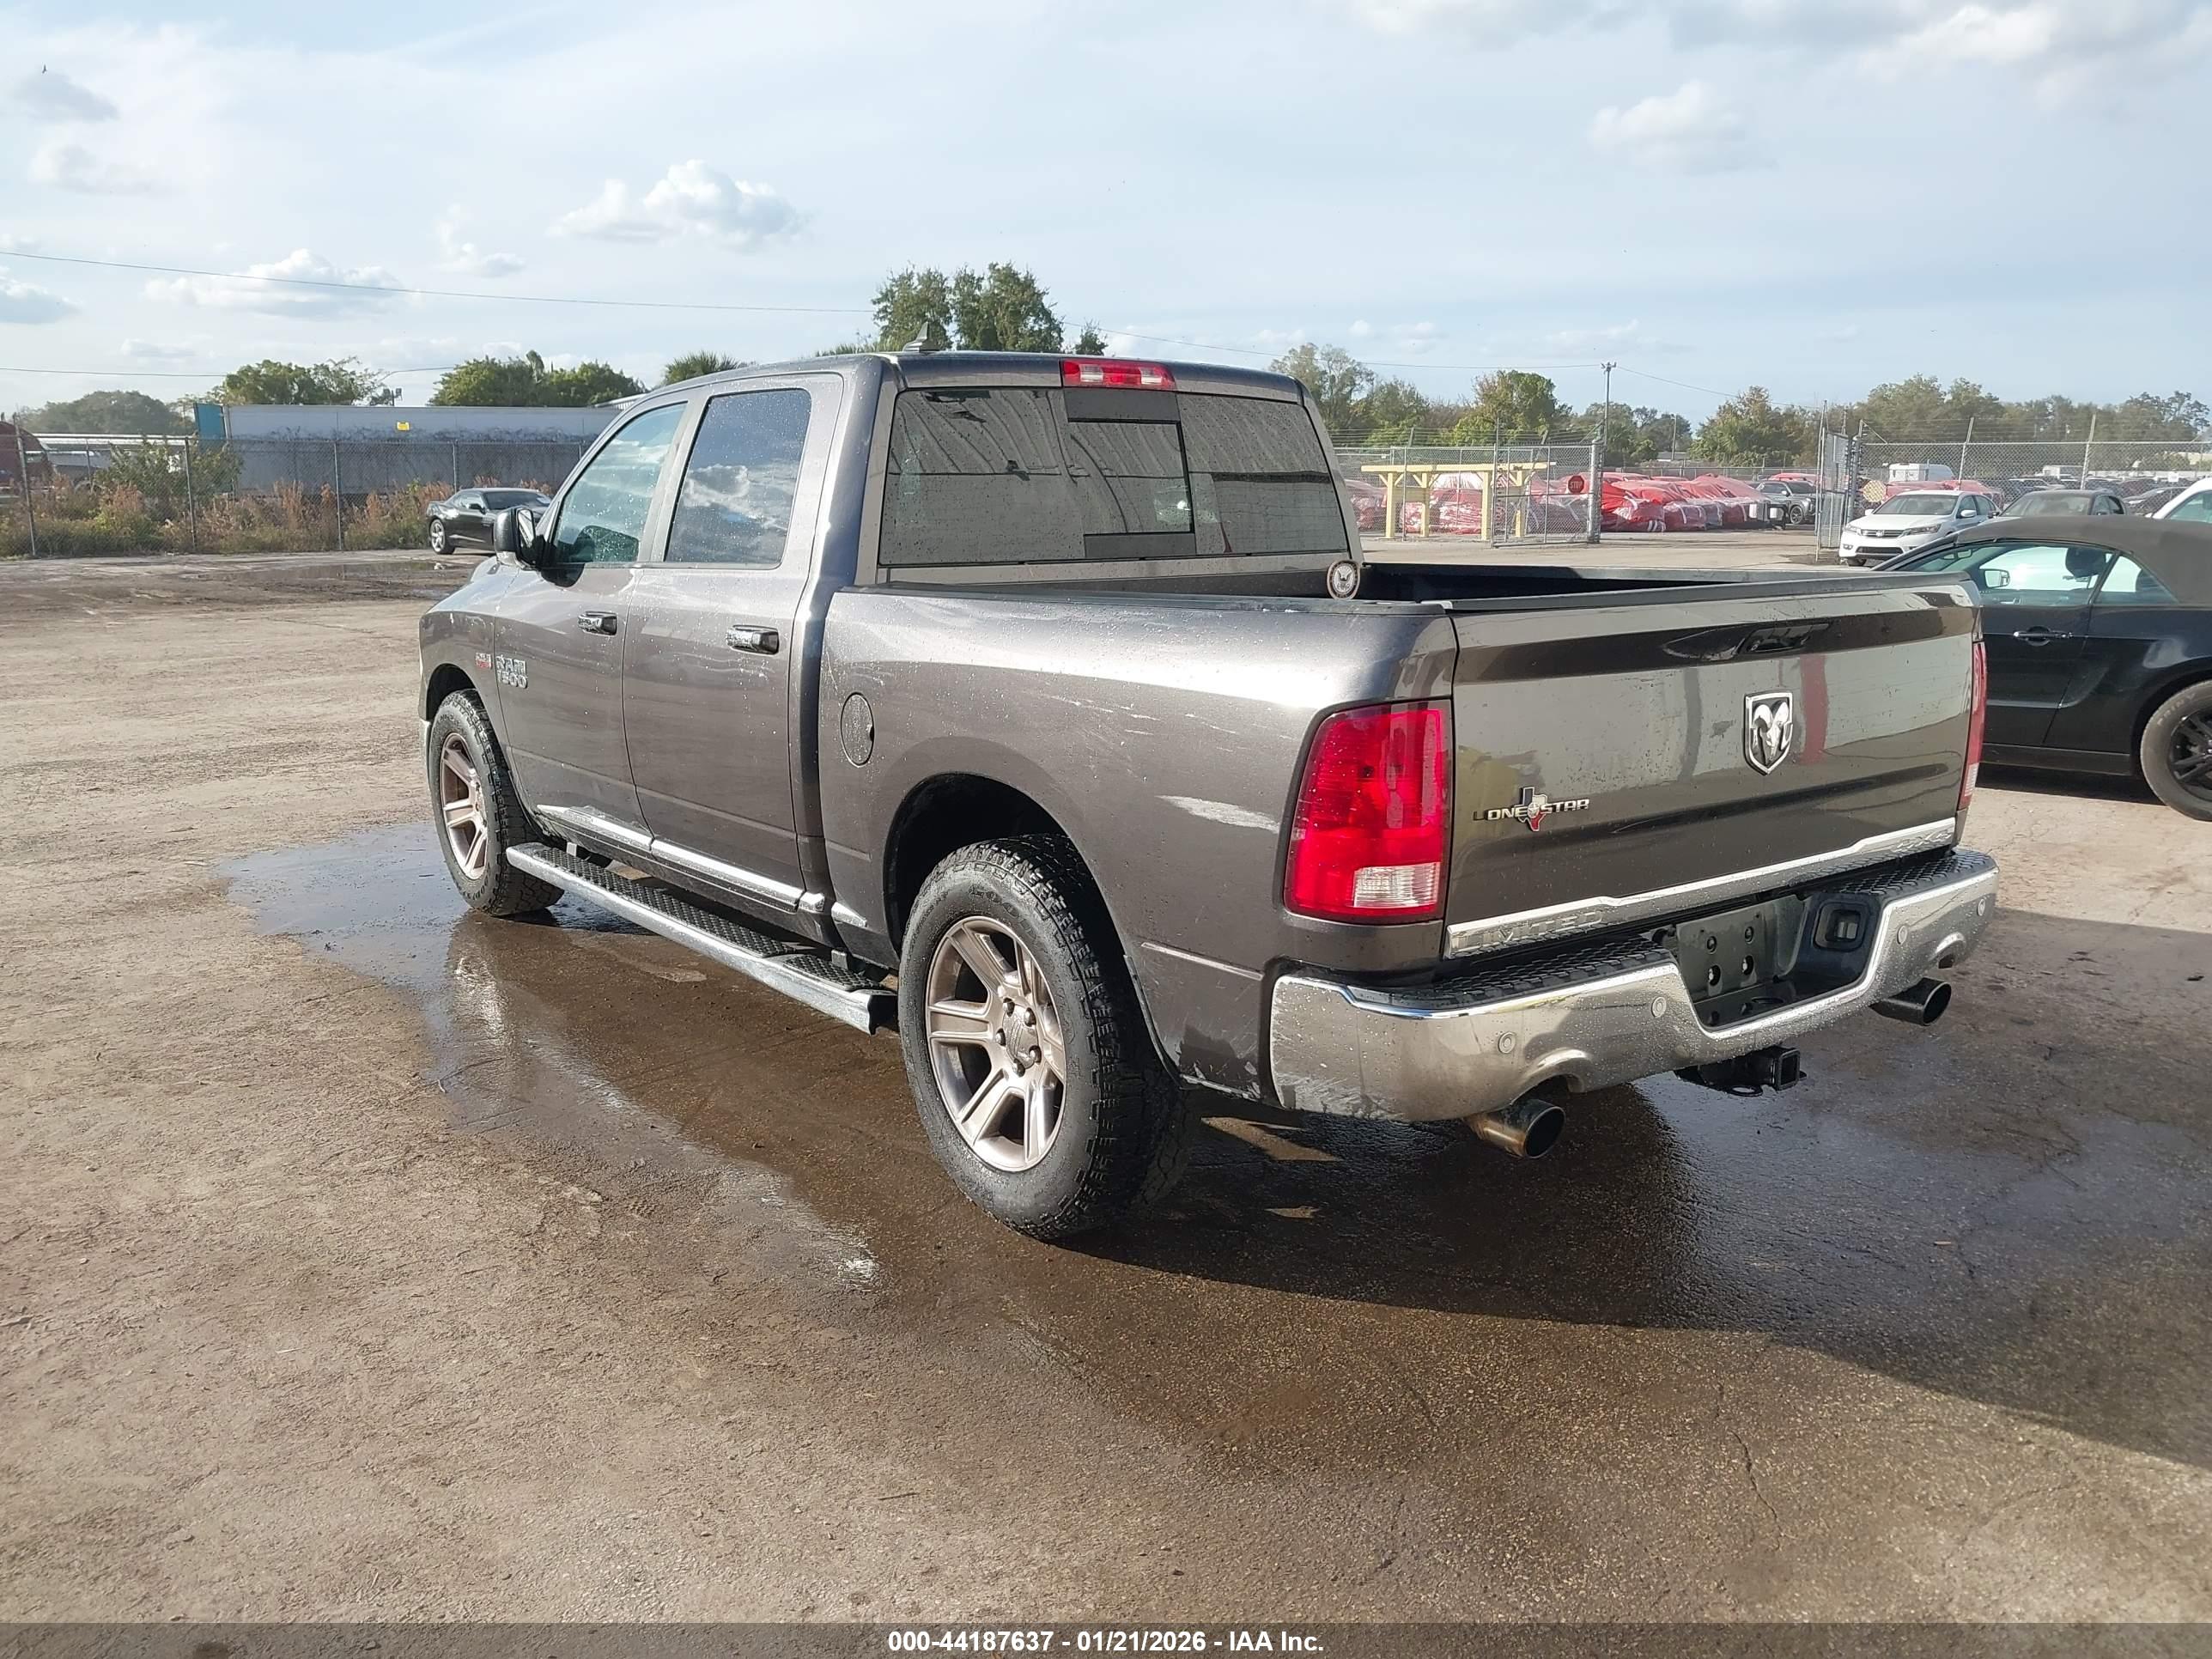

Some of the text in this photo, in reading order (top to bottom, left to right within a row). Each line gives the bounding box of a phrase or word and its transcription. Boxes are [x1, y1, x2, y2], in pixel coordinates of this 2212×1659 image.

[495, 655, 526, 675] RAM
[497, 670, 527, 688] 1500
[1473, 799, 1590, 821] LONE STAR
